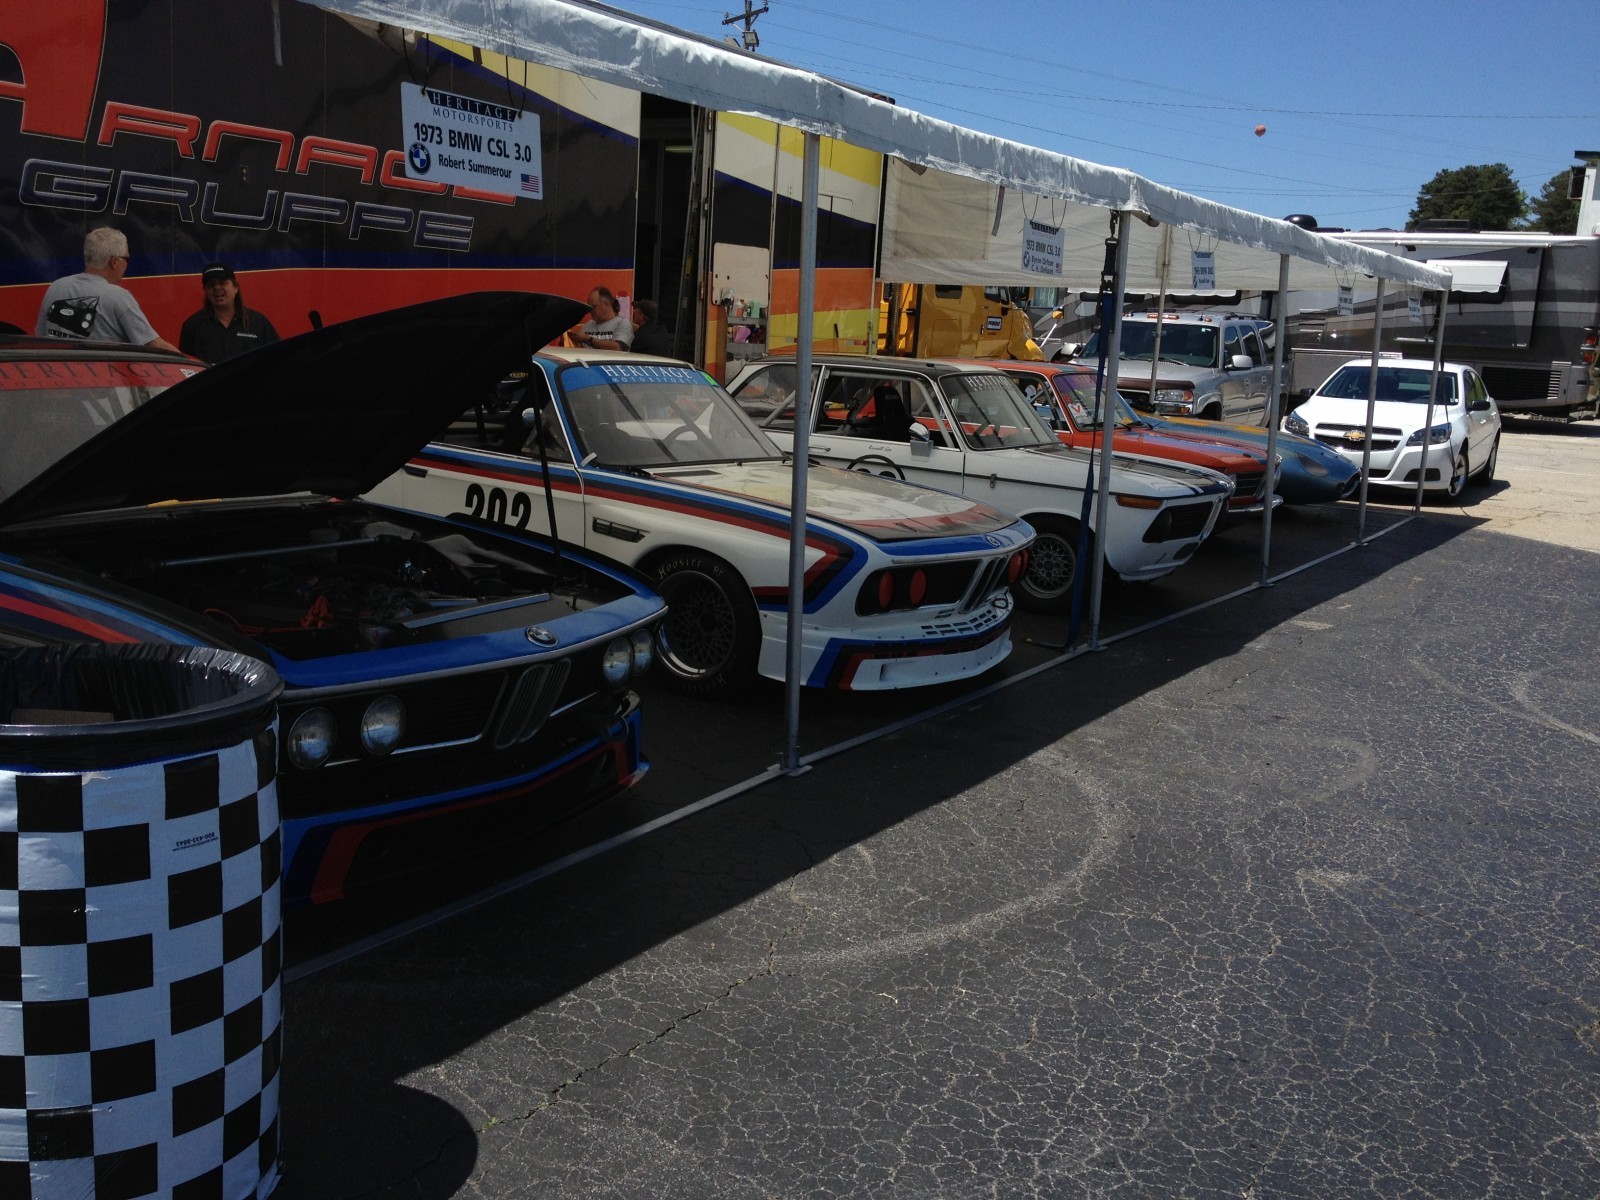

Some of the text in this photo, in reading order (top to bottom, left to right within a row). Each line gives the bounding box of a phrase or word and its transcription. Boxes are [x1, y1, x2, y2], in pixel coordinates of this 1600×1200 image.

[432, 92, 513, 122] HERITAGE
[432, 107, 514, 132] MOTORSPORTS
[413, 122, 532, 163] 1973 BMW CSL 3.0
[438, 153, 512, 179] Robert Summerour
[19, 158, 474, 252] GRUPPE
[600, 365, 693, 379] HERITAGE
[465, 483, 531, 530] 202
